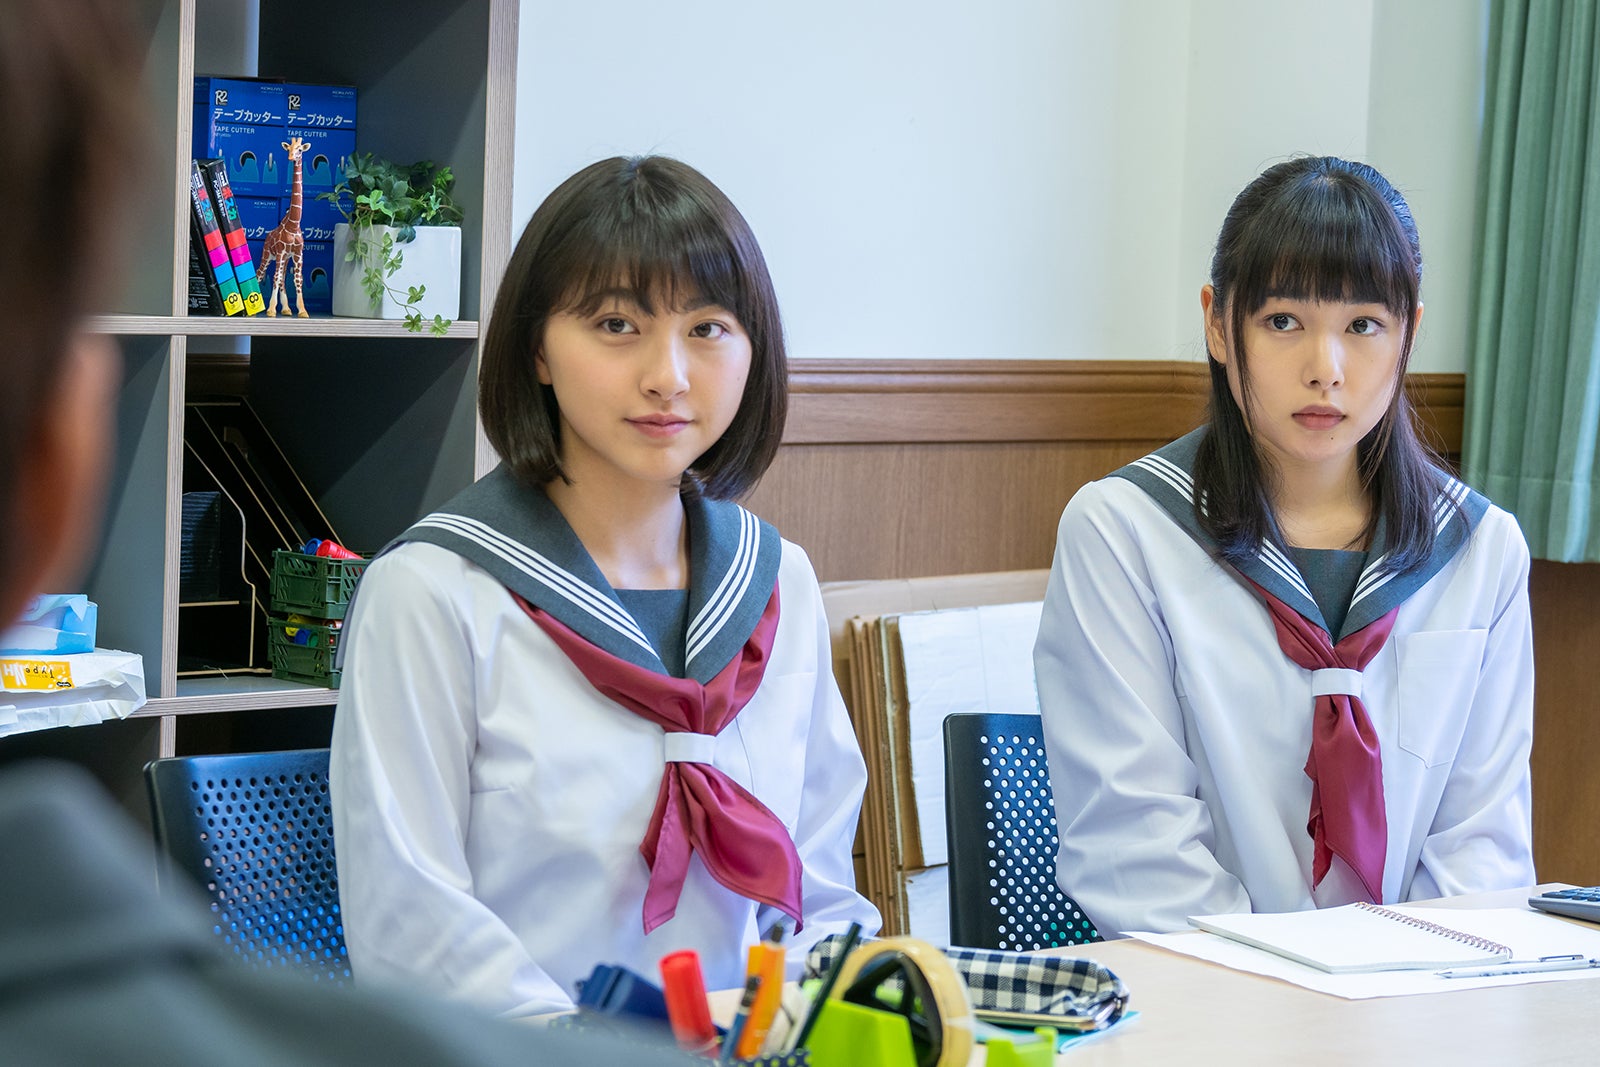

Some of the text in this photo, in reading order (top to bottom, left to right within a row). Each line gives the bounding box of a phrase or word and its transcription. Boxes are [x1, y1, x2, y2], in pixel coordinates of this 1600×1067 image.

[214, 107, 282, 123] テープカッター
[287, 112, 353, 127] テープカッター
[214, 125, 255, 134] TAPE CUTTER
[244, 226, 273, 240] ッター
